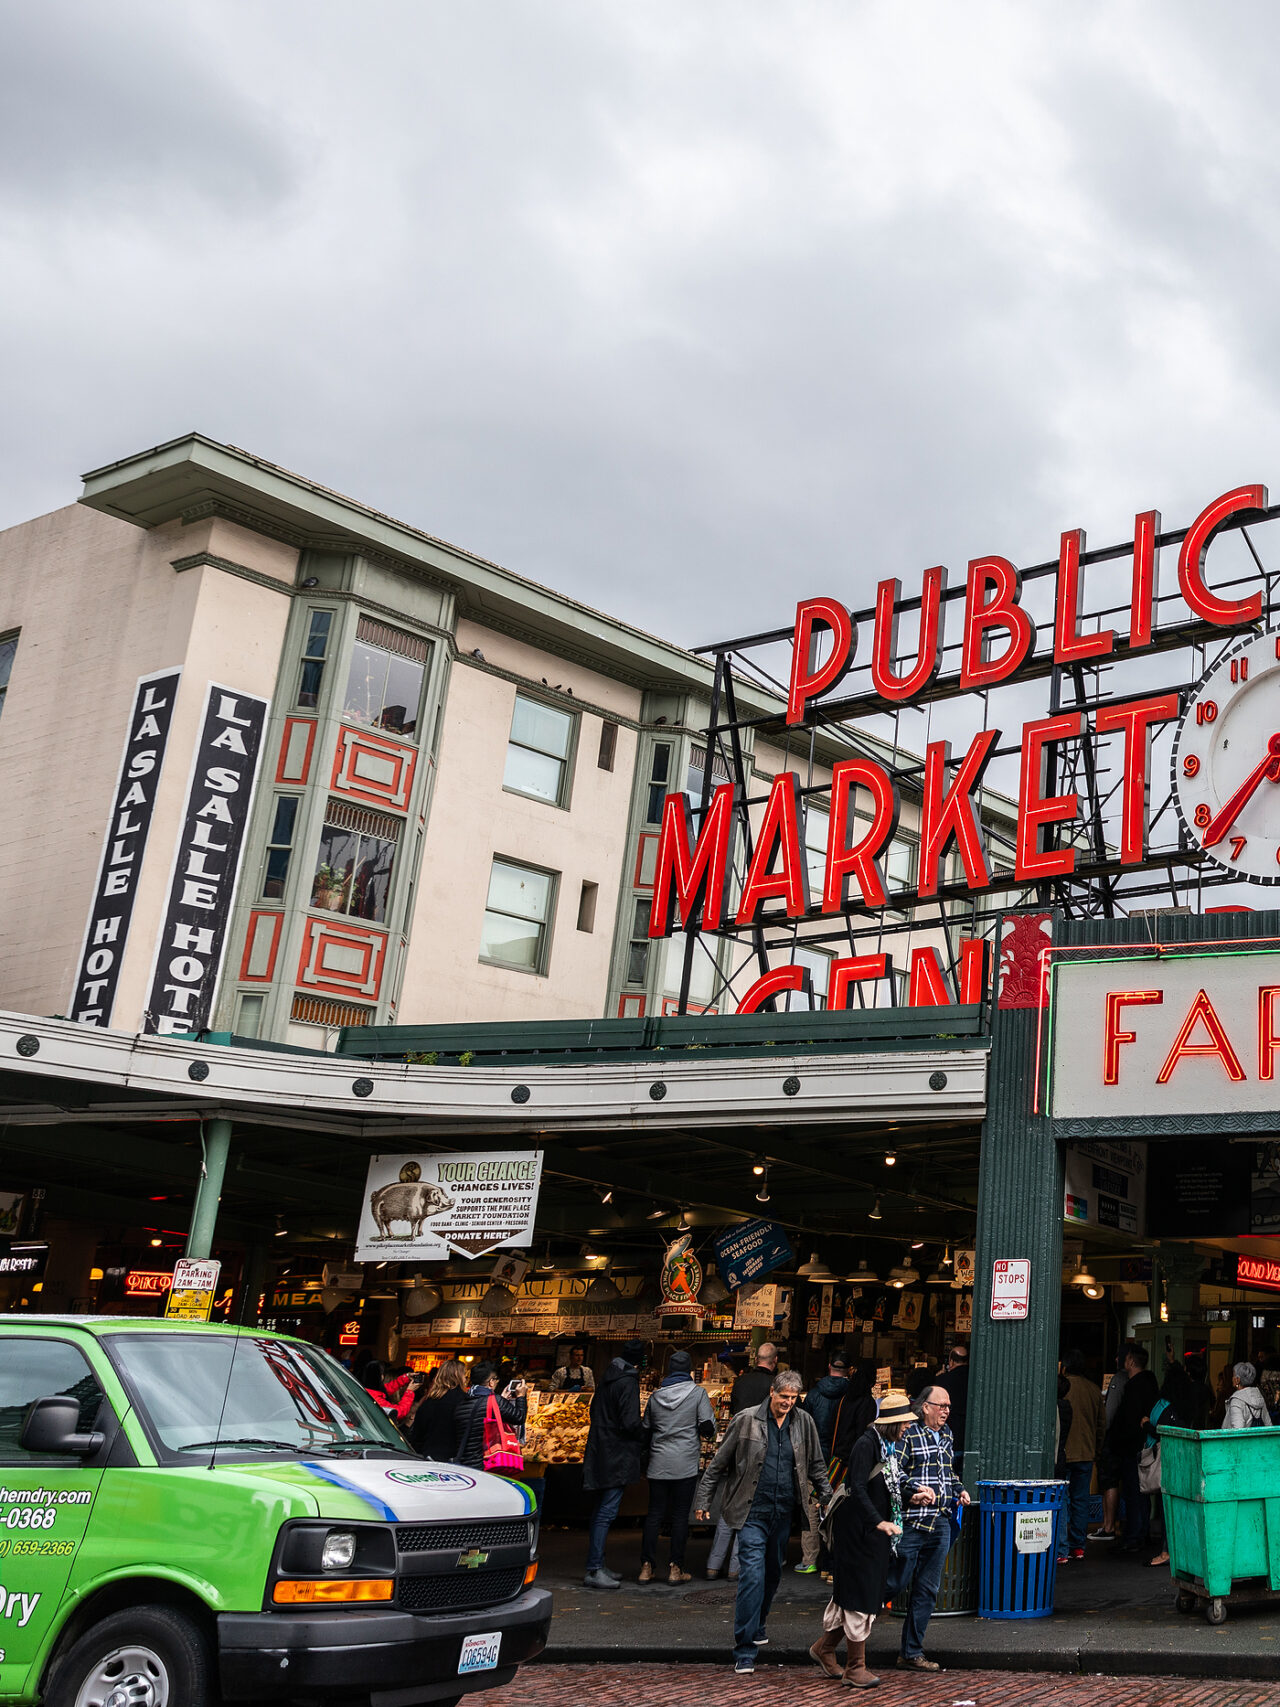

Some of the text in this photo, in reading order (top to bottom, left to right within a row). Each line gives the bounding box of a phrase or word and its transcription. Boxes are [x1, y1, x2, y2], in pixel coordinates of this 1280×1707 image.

[786, 483, 1268, 726] PUBLIC
[1230, 657, 1248, 683] 11
[134, 687, 167, 742] LA
[1196, 700, 1218, 725] 10
[210, 694, 251, 756] LA
[1183, 754, 1200, 778] 9
[103, 750, 156, 898] SALLE
[648, 693, 1180, 939] MARKET
[1194, 804, 1211, 828] 8
[179, 766, 241, 911] SALLE
[1229, 836, 1247, 861] 7
[438, 1161, 537, 1182] YOUR CHANGE
[451, 1182, 534, 1191] CHANGES LIVES!
[445, 1232, 482, 1240] DONATE
[720, 1223, 773, 1258] OCEAN-FRIENDLY
[731, 1238, 764, 1260] SEAFOOD
[181, 1270, 212, 1278] PARKING
[996, 1262, 1006, 1271] NO
[177, 1279, 212, 1288] 2AM-7AM
[998, 1274, 1025, 1284] STOPS
[657, 1306, 702, 1314] WORLD FAMOUS
[1020, 1516, 1049, 1524] RECYCLE
[12, 1541, 75, 1556] 659-2366
